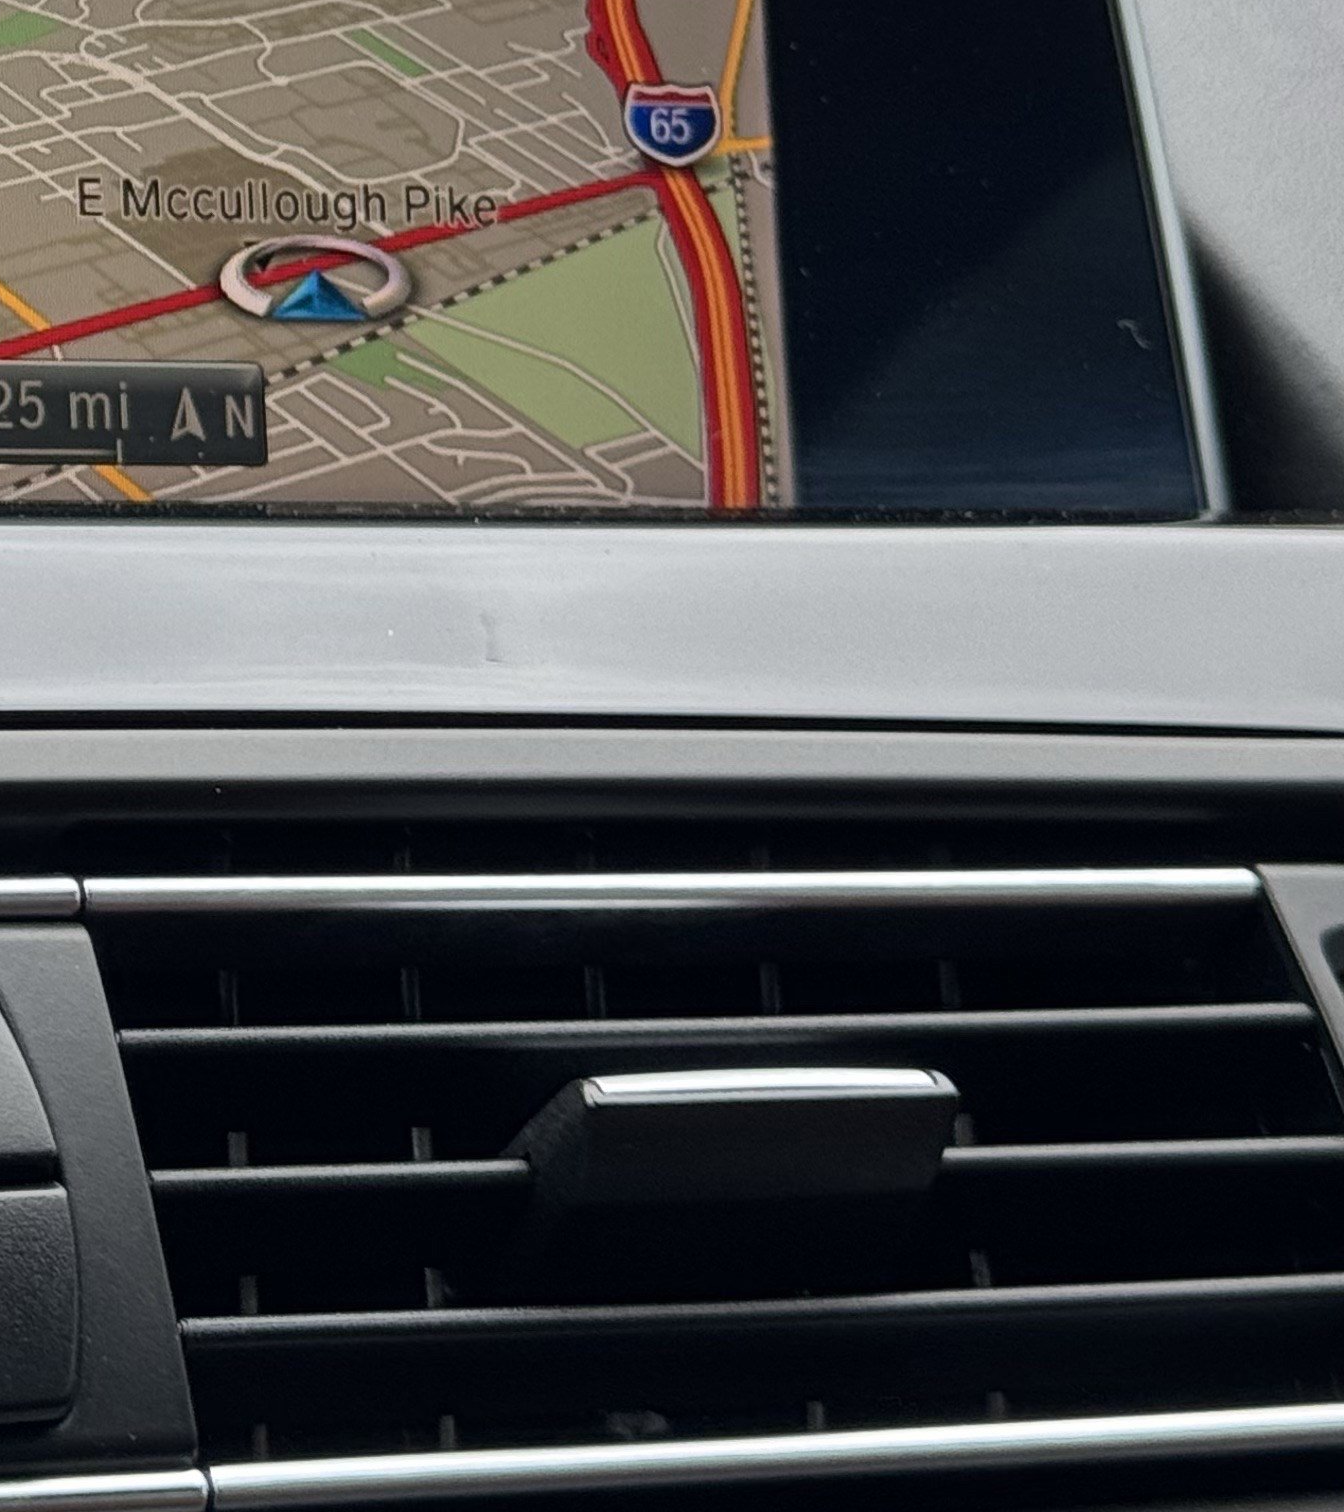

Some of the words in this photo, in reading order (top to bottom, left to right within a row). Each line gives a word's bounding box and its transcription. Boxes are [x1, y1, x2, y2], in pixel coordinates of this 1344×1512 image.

[650, 106, 693, 143] 65
[77, 178, 103, 217] E
[122, 178, 387, 231] Mccullough
[405, 185, 498, 227] Pike
[68, 379, 131, 433] mi
[225, 396, 255, 438] N
